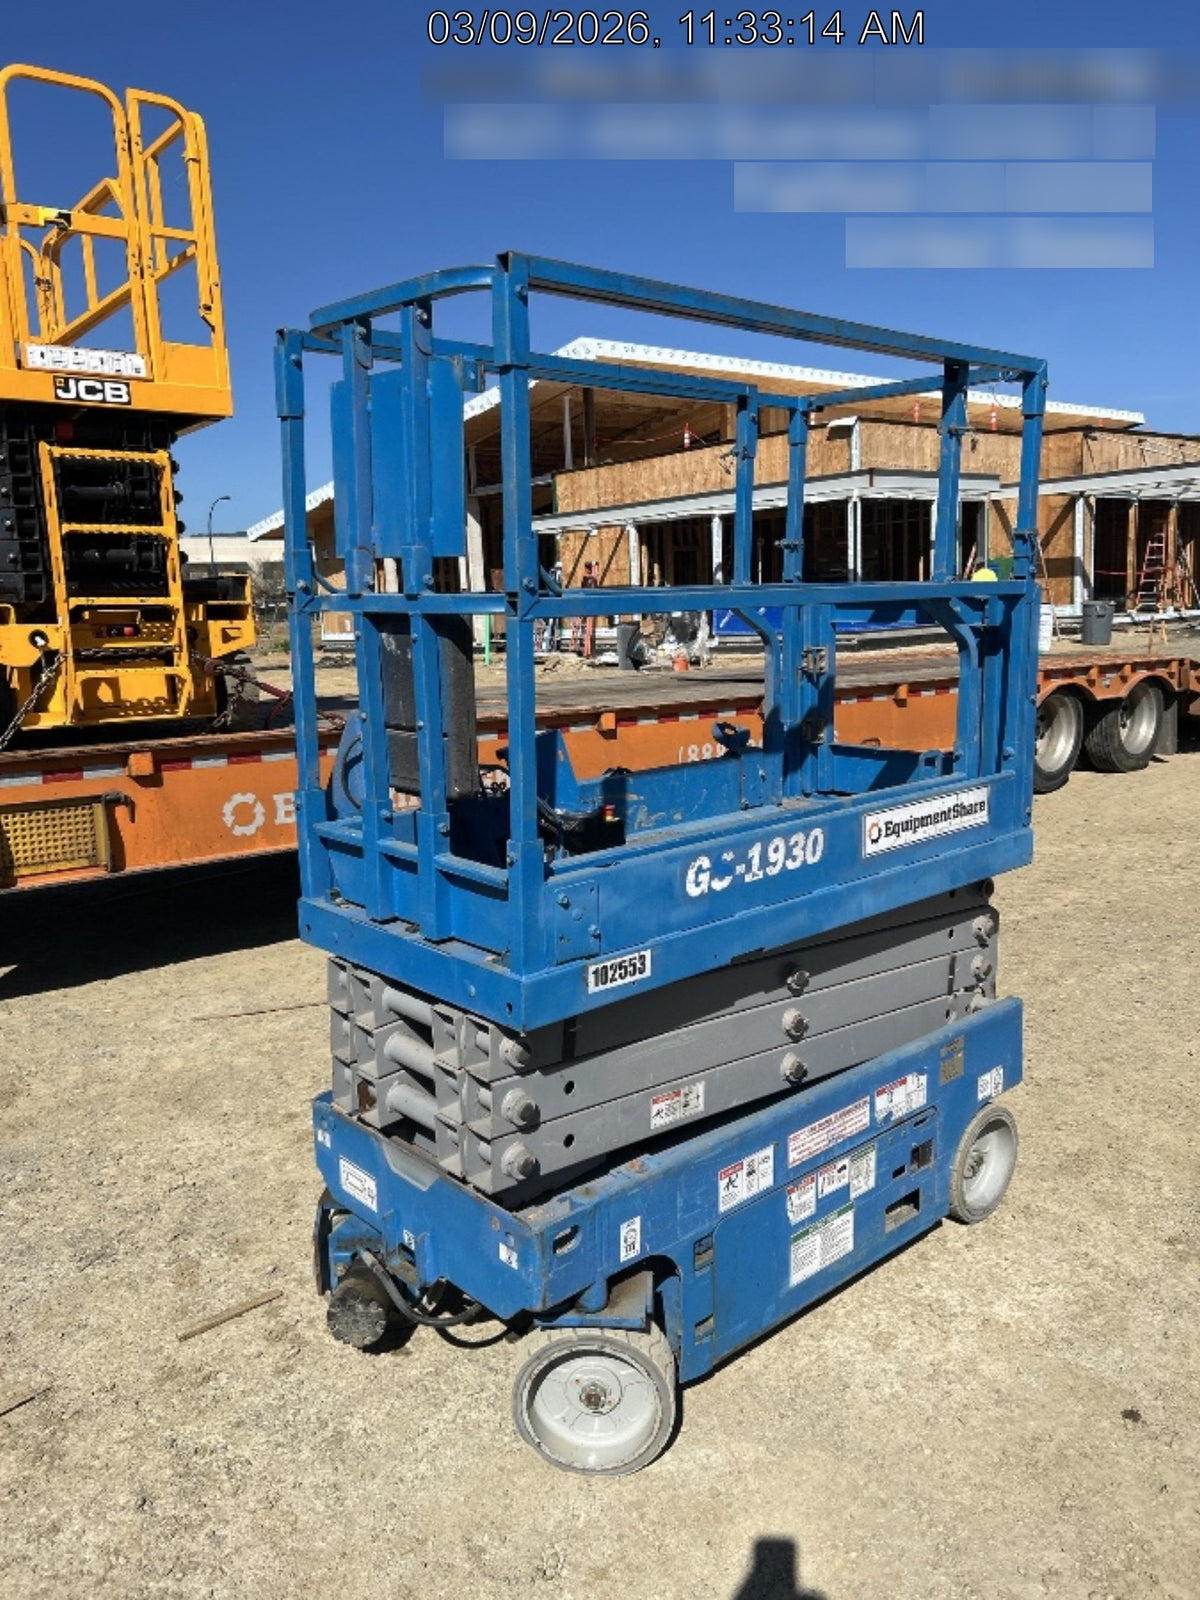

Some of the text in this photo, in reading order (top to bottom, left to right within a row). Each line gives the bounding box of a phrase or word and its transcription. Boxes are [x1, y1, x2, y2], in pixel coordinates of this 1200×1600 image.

[55, 378, 130, 403] JCB
[883, 800, 986, 838] EquipmentShare
[591, 953, 647, 988] 102553
